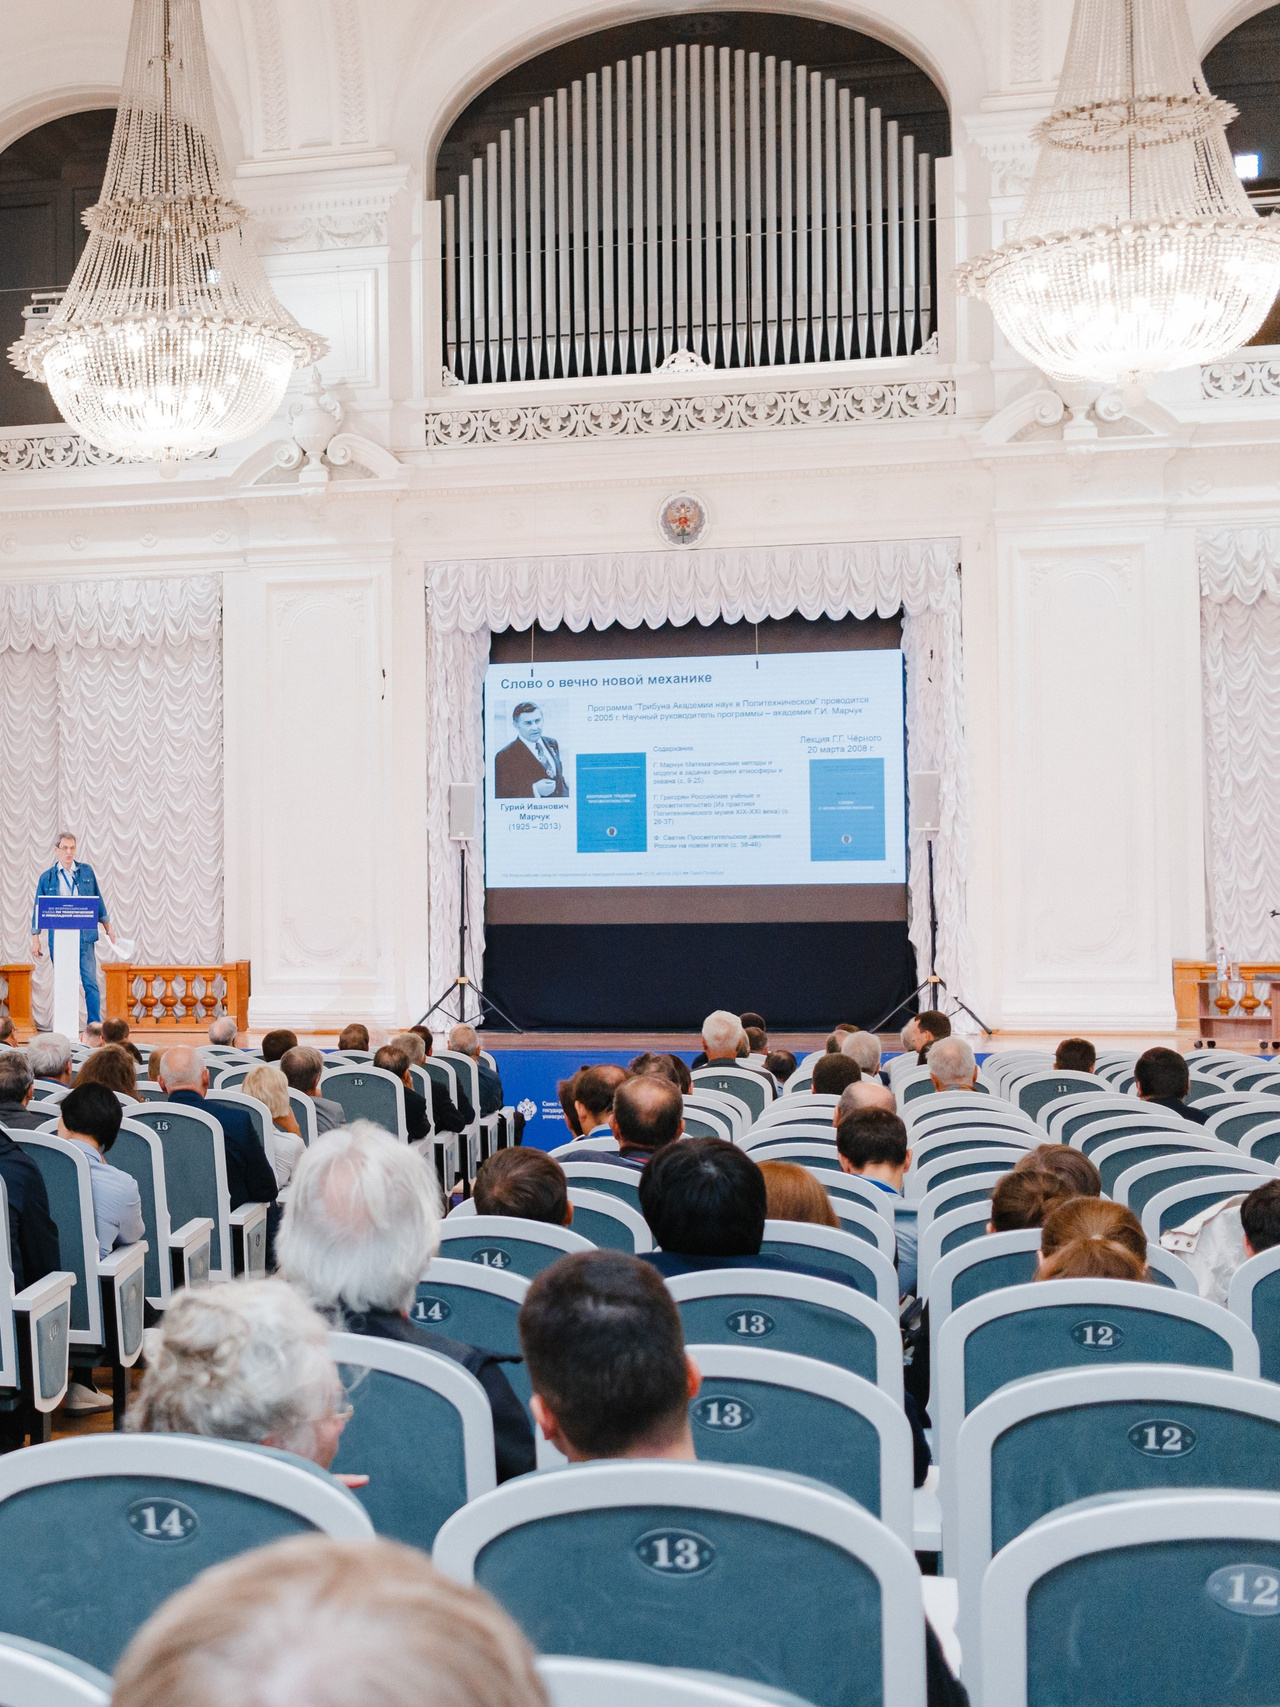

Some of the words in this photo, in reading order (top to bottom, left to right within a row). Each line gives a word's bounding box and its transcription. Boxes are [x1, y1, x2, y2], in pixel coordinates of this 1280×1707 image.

[500, 678, 542, 690] Слово
[546, 680, 555, 688] о
[559, 678, 598, 688] вечно
[602, 674, 643, 686] новой
[647, 674, 712, 685] механике
[587, 704, 633, 715] Программа
[672, 701, 714, 712] Академии
[715, 701, 735, 710] наук
[742, 697, 819, 708] Политехническом"
[820, 697, 869, 706] проводится
[594, 712, 614, 722] 2005
[622, 712, 658, 722] Научный
[660, 711, 716, 722] руководитель
[717, 710, 764, 720] программы
[772, 708, 812, 718] академик
[832, 706, 863, 716] Марчук
[800, 736, 830, 746] Лекция
[847, 734, 882, 744] Чёрного
[807, 746, 818, 754] 20
[820, 746, 844, 754] марта
[847, 744, 868, 752] 2008
[730, 792, 755, 800] учёные
[500, 803, 525, 812] Гурий
[527, 802, 569, 810] Иванович
[519, 813, 550, 821] Марчук
[508, 823, 530, 831] (1925
[539, 822, 562, 831] 2013)
[354, 1078, 363, 1086] 15
[1057, 1085, 1067, 1093] 11
[156, 1121, 168, 1131] 15
[481, 1252, 504, 1268] 14
[416, 1302, 442, 1319] 14
[737, 1315, 766, 1334] 13
[1083, 1326, 1112, 1345] 12
[707, 1404, 742, 1426] 13
[1143, 1427, 1182, 1450] 12
[142, 1506, 184, 1536] 14
[652, 1538, 699, 1569] 13
[1228, 1574, 1280, 1606] 12
